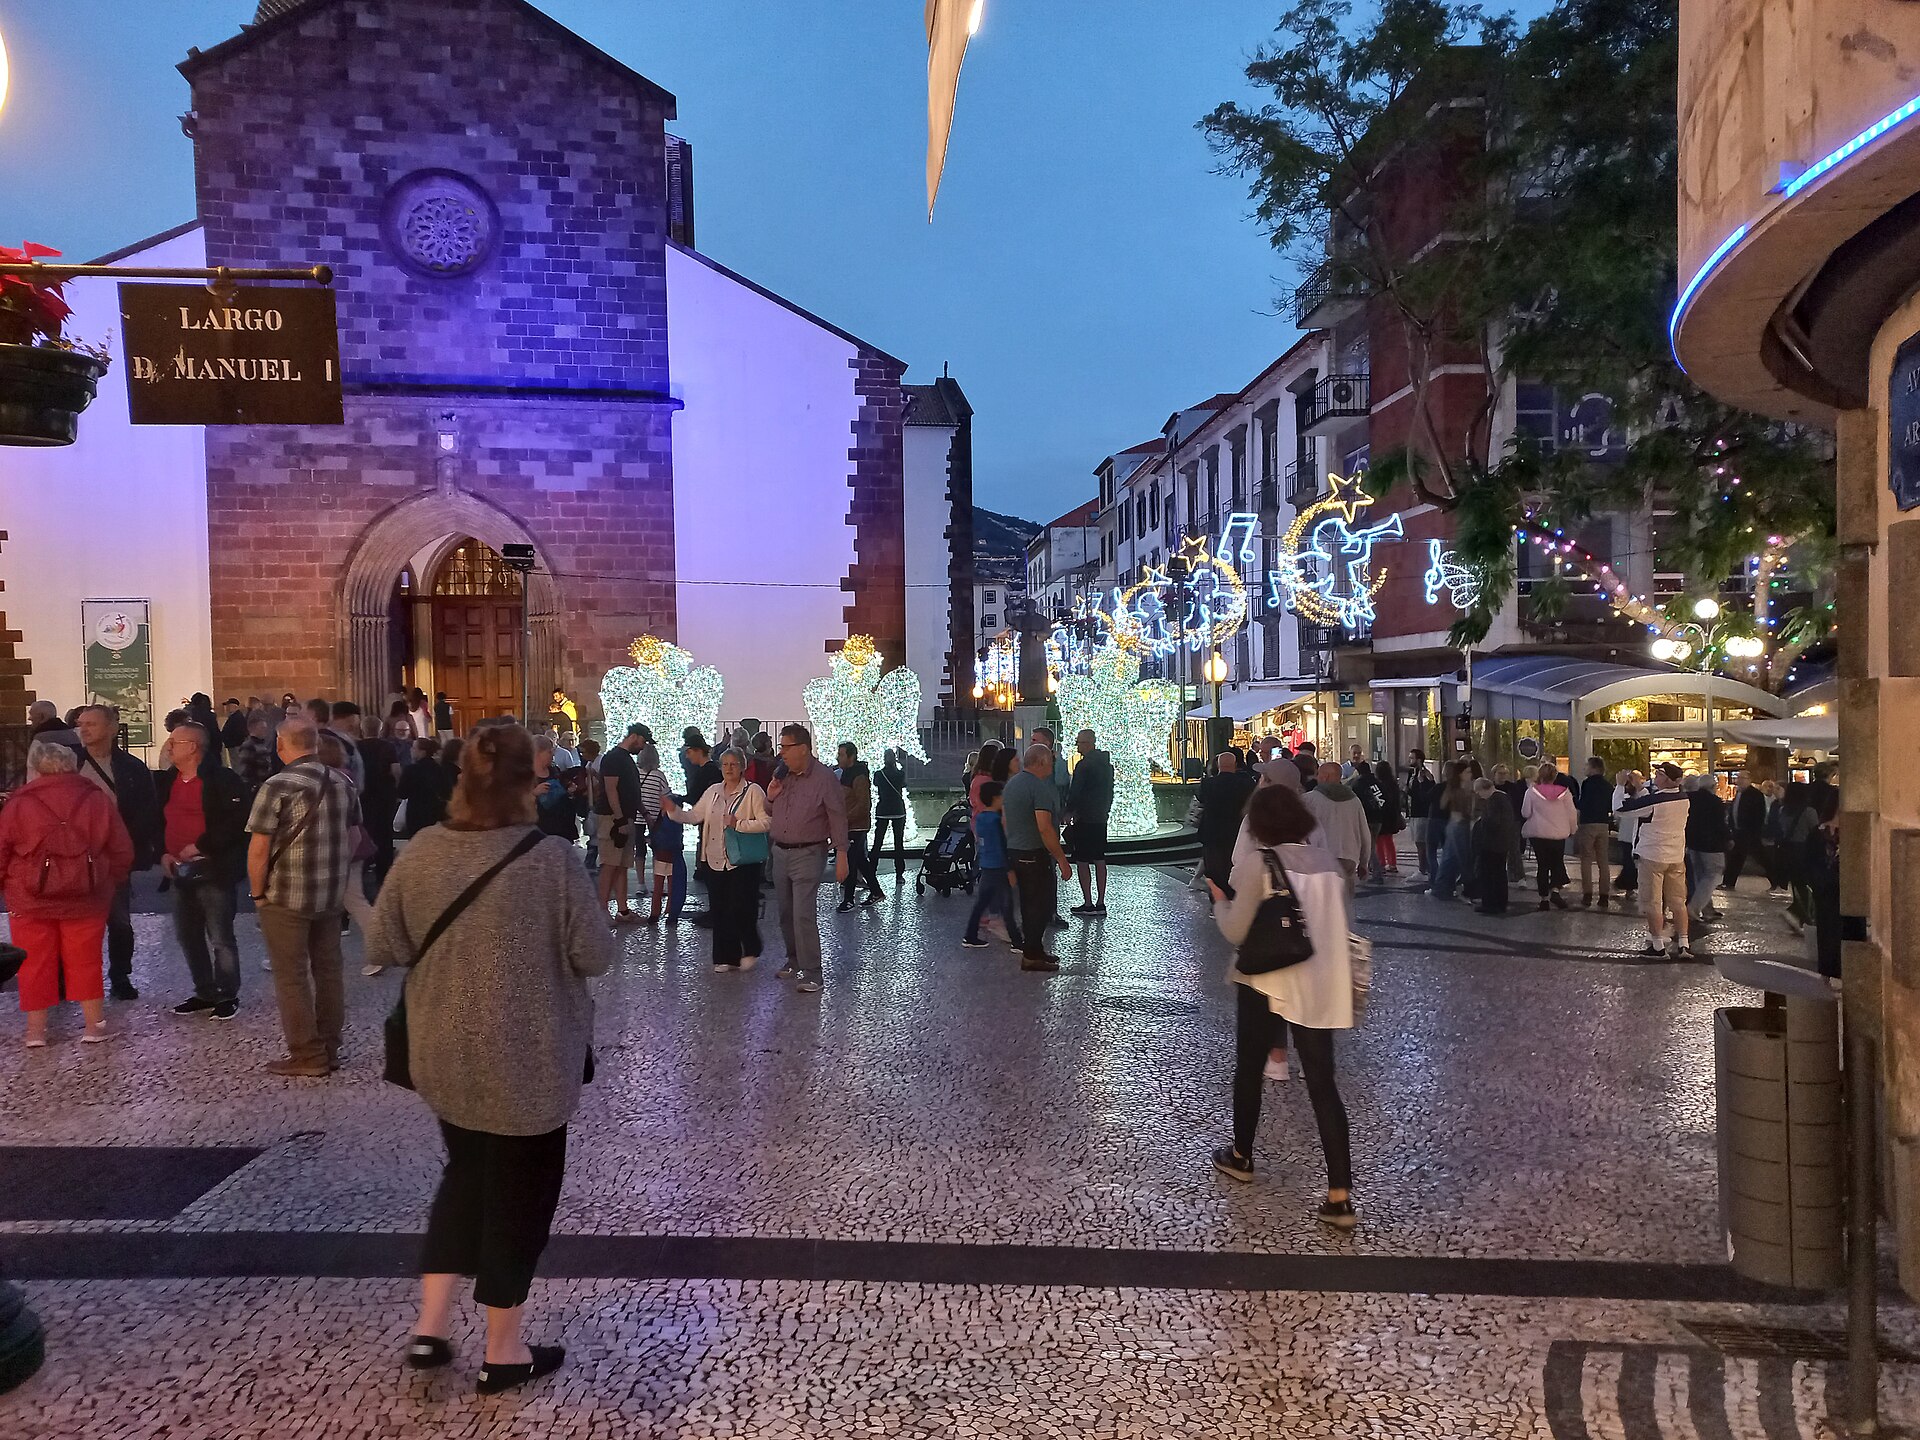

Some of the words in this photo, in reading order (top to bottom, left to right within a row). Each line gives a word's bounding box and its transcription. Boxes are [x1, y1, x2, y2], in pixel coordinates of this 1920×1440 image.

[179, 307, 283, 331] LARGO
[173, 357, 301, 381] MANUEL
[325, 359, 333, 382] I
[1369, 784, 1386, 808] FILA
